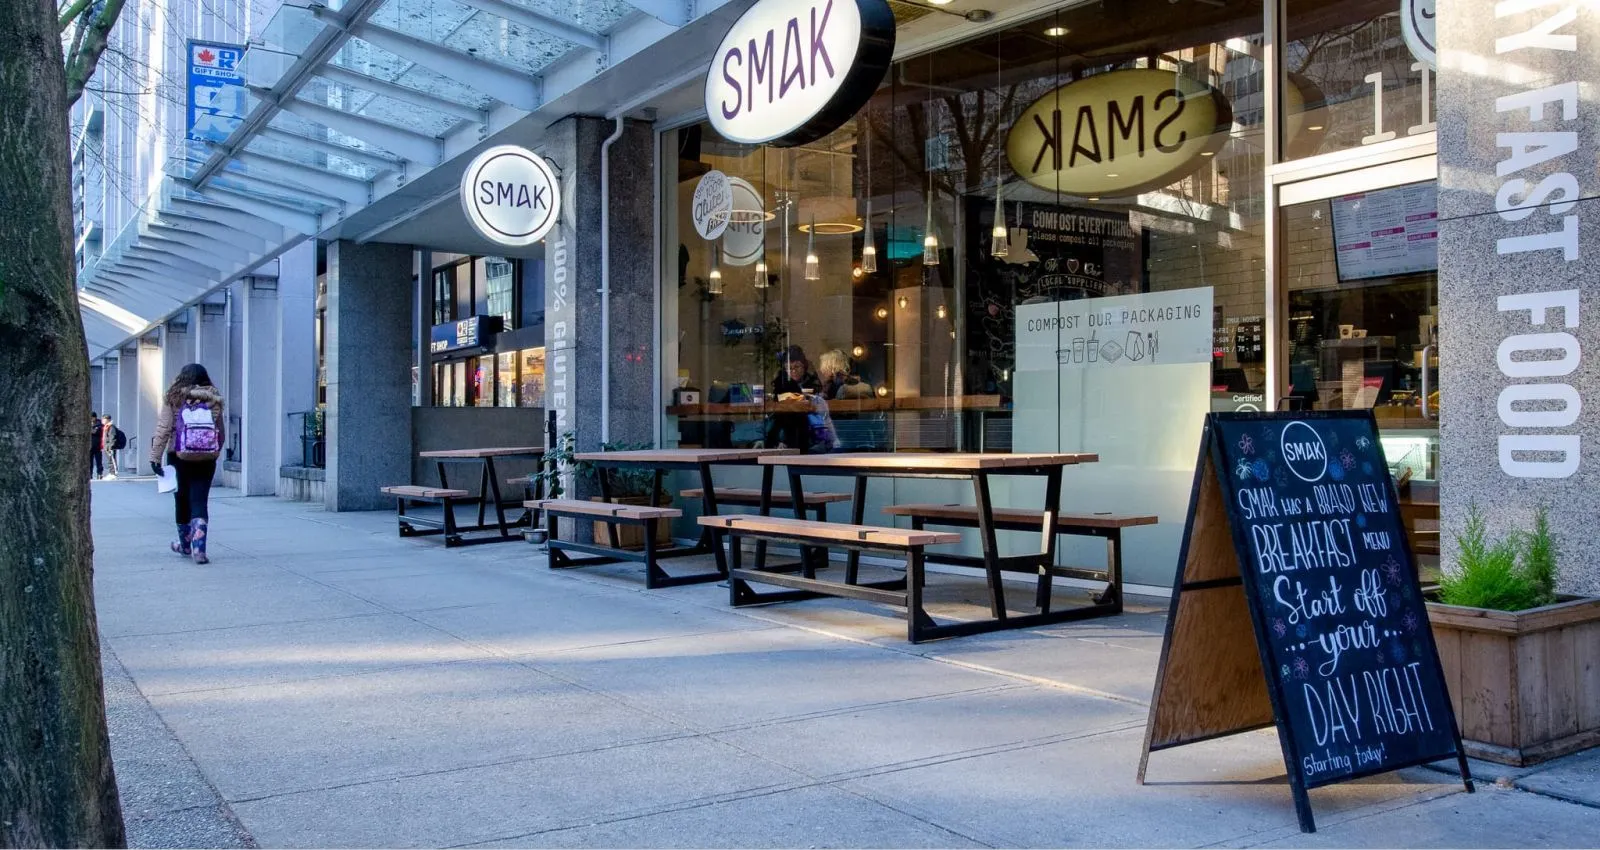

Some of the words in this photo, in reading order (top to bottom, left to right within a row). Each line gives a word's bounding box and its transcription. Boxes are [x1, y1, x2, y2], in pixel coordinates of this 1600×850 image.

[1495, 0, 1578, 54] Y
[194, 67, 213, 76] GIFT
[721, 0, 835, 121] SMAK
[479, 179, 547, 211] SMAK
[1495, 81, 1580, 262] FAST
[553, 236, 567, 312] 100%
[1027, 315, 1081, 332] COMPOST
[1088, 312, 1113, 328] OUR
[1121, 303, 1202, 325] PACKAGING
[553, 320, 567, 426] GLUTEN
[1232, 394, 1263, 403] Certified
[1496, 288, 1582, 479] FOOD
[1284, 441, 1324, 462] SMAK
[1238, 487, 1277, 520] SMAK
[1280, 498, 1302, 517] HAS
[1306, 499, 1313, 514] A
[1313, 483, 1355, 515] BRAND
[1357, 482, 1388, 514] NEW
[1252, 517, 1357, 574] BREAKFAST
[1362, 531, 1391, 551] MENU
[1273, 574, 1346, 625] Start
[1353, 568, 1387, 618] off
[1303, 674, 1361, 747] DAY
[1363, 662, 1434, 735] RIGHT
[1303, 748, 1352, 776] Starting
[1354, 741, 1388, 766] today!
